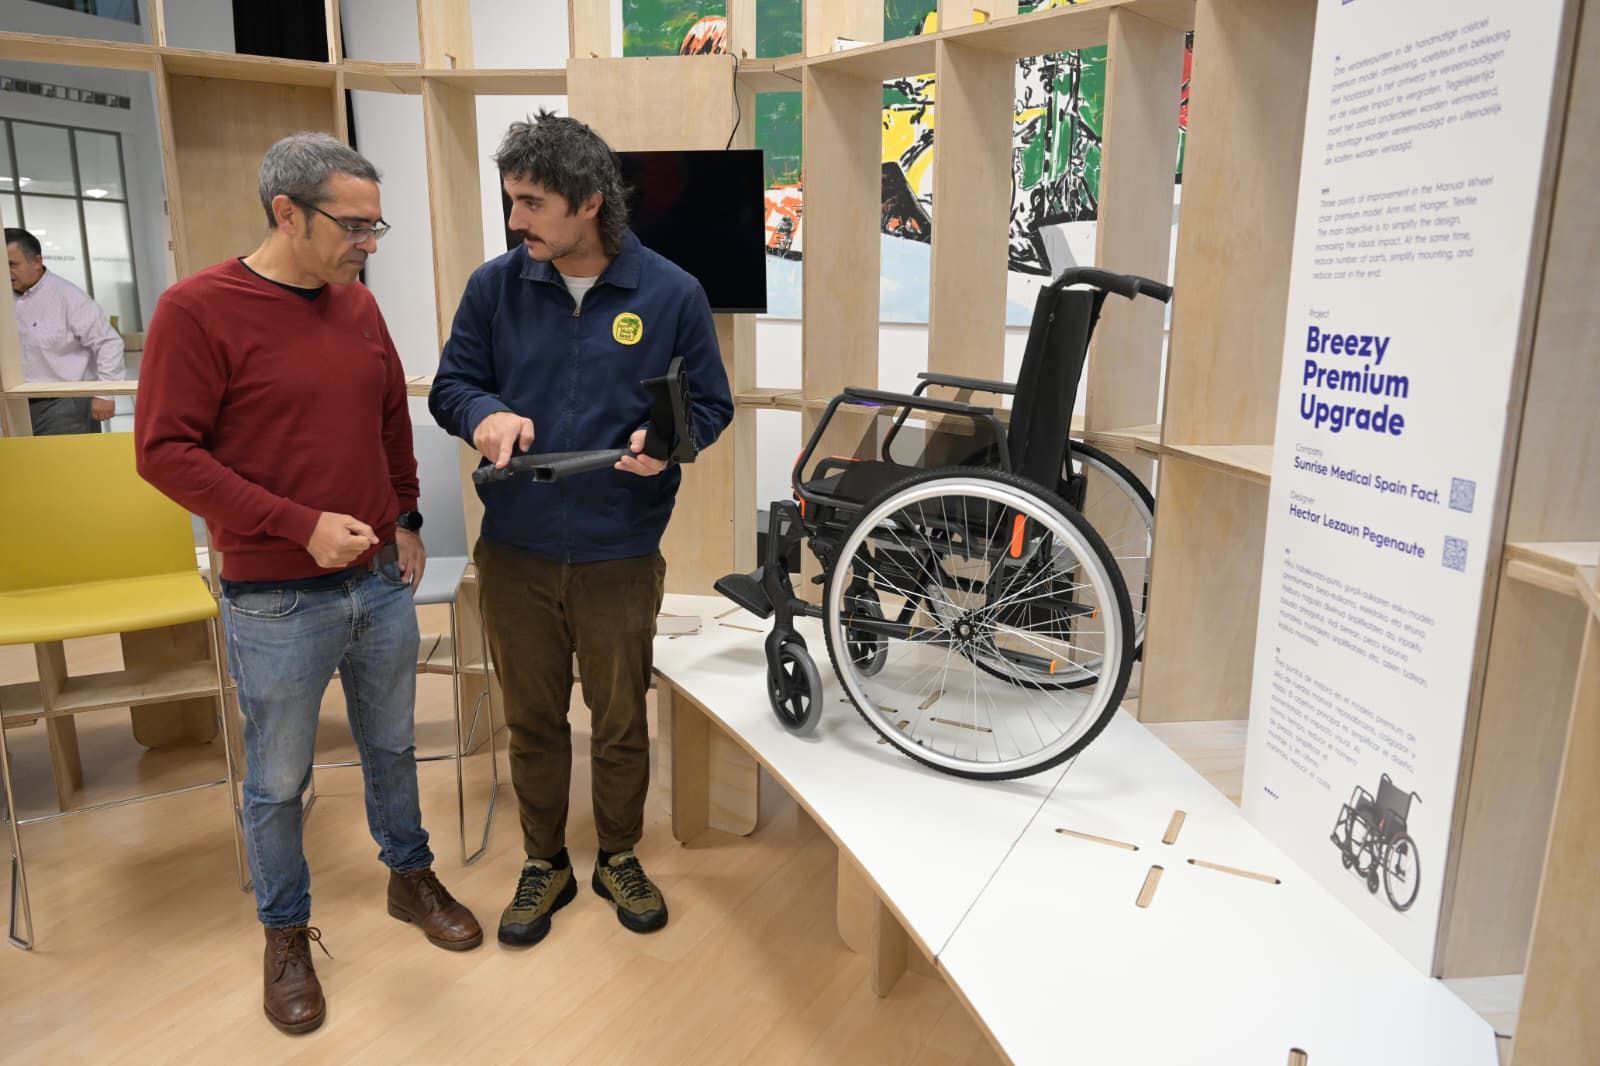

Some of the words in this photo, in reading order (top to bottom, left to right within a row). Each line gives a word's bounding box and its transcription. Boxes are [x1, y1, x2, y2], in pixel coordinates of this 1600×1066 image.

[1420, 185, 1433, 195] the
[1435, 180, 1465, 193] Manual
[1420, 219, 1433, 227] the
[1415, 235, 1427, 244] the
[1456, 249, 1474, 258] and
[1306, 326, 1391, 366] Breezy
[1303, 359, 1410, 399] Premium
[1299, 393, 1406, 437] Upgrade
[1295, 443, 1324, 459] Company
[1294, 456, 1328, 476] Sunrise
[1330, 465, 1372, 487] Medical
[1374, 476, 1408, 497] Spain
[1410, 484, 1440, 505] Fact.
[1290, 490, 1315, 506] Designer
[1289, 503, 1321, 525] Hector
[1323, 514, 1360, 538] Lezaun
[1362, 526, 1425, 560] Pegenaute
